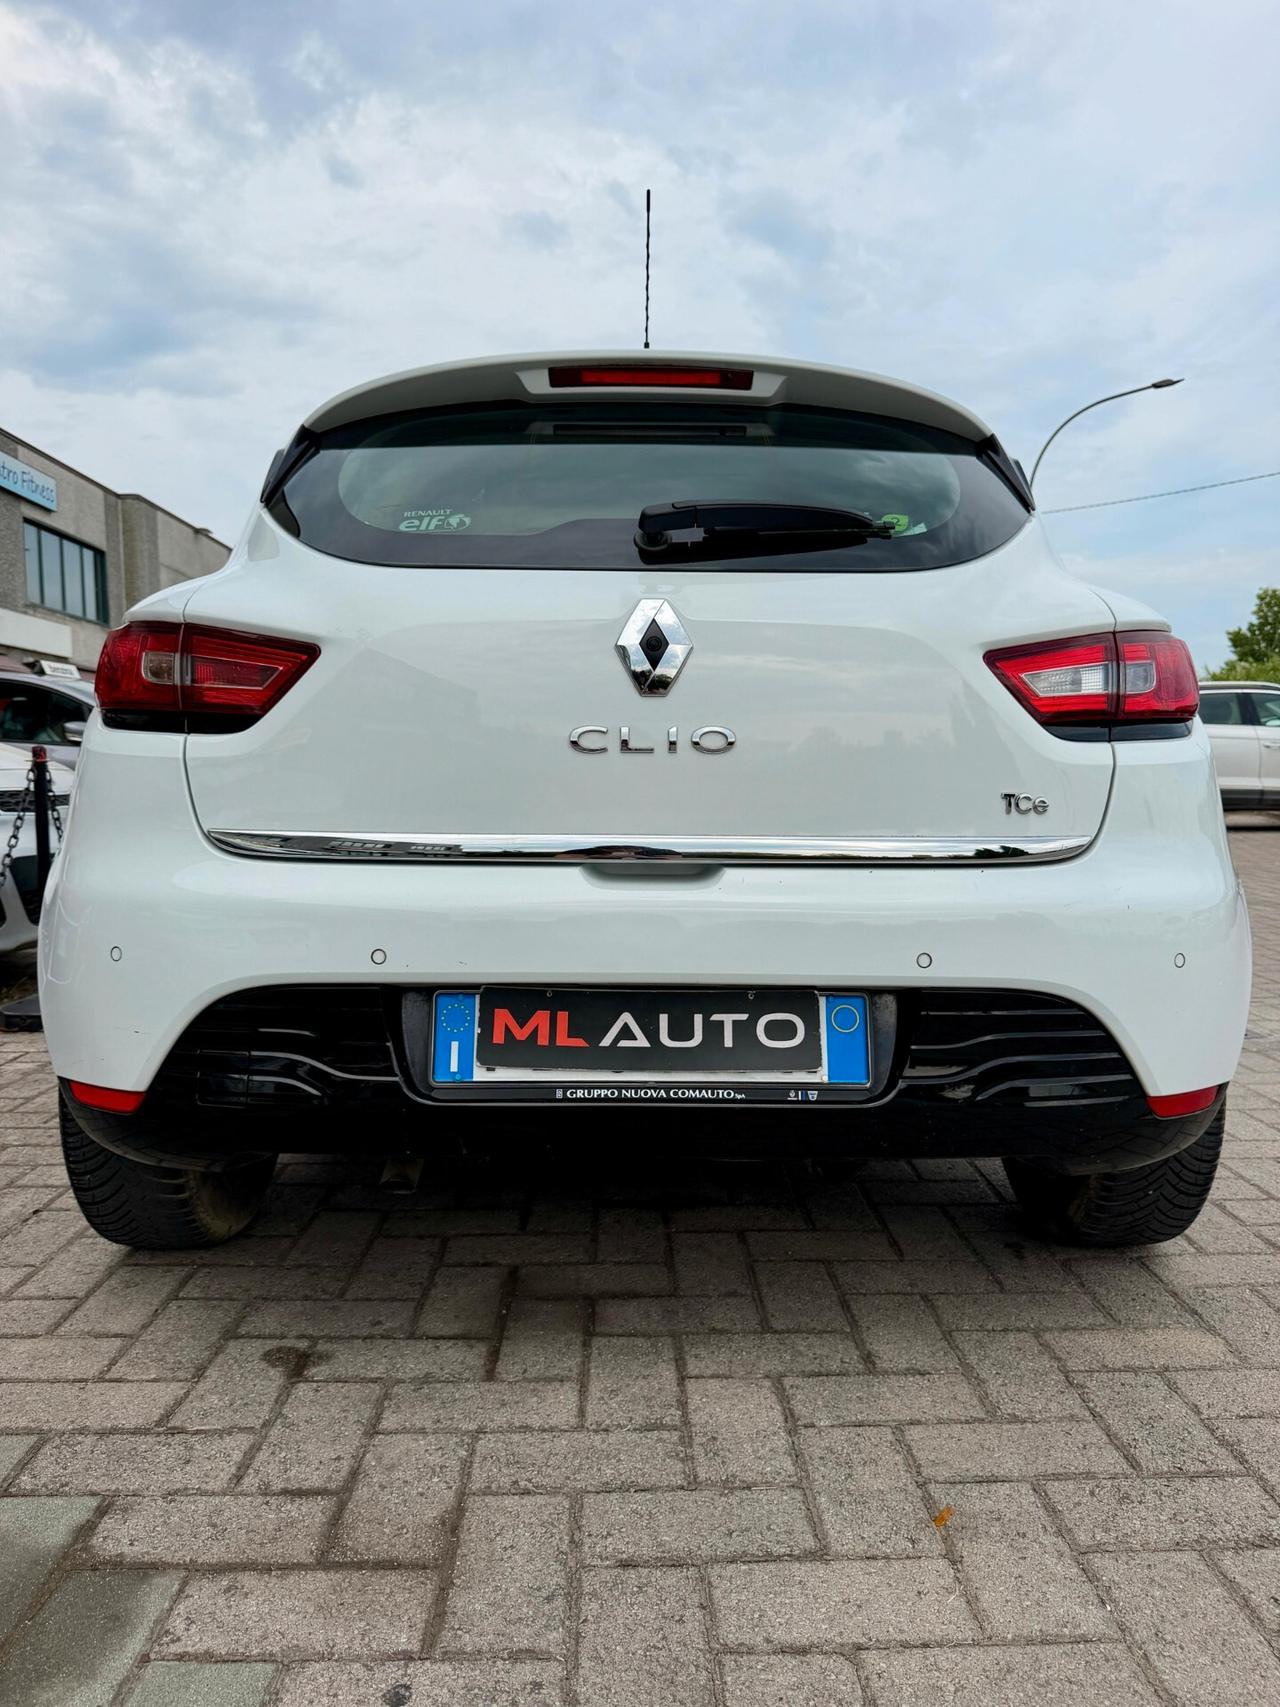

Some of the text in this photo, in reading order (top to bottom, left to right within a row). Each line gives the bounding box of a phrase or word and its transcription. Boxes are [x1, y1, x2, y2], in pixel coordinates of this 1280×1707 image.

[0, 461, 54, 502] tro Fitness
[399, 515, 444, 531] elf
[403, 509, 452, 517] RENAULT
[569, 724, 737, 755] CLIO
[1000, 792, 1050, 815] TCe
[450, 1041, 459, 1072] I
[566, 1088, 619, 1099] GRUPPO
[621, 1088, 666, 1099] NUOVA
[669, 1088, 735, 1099] COMAUTO
